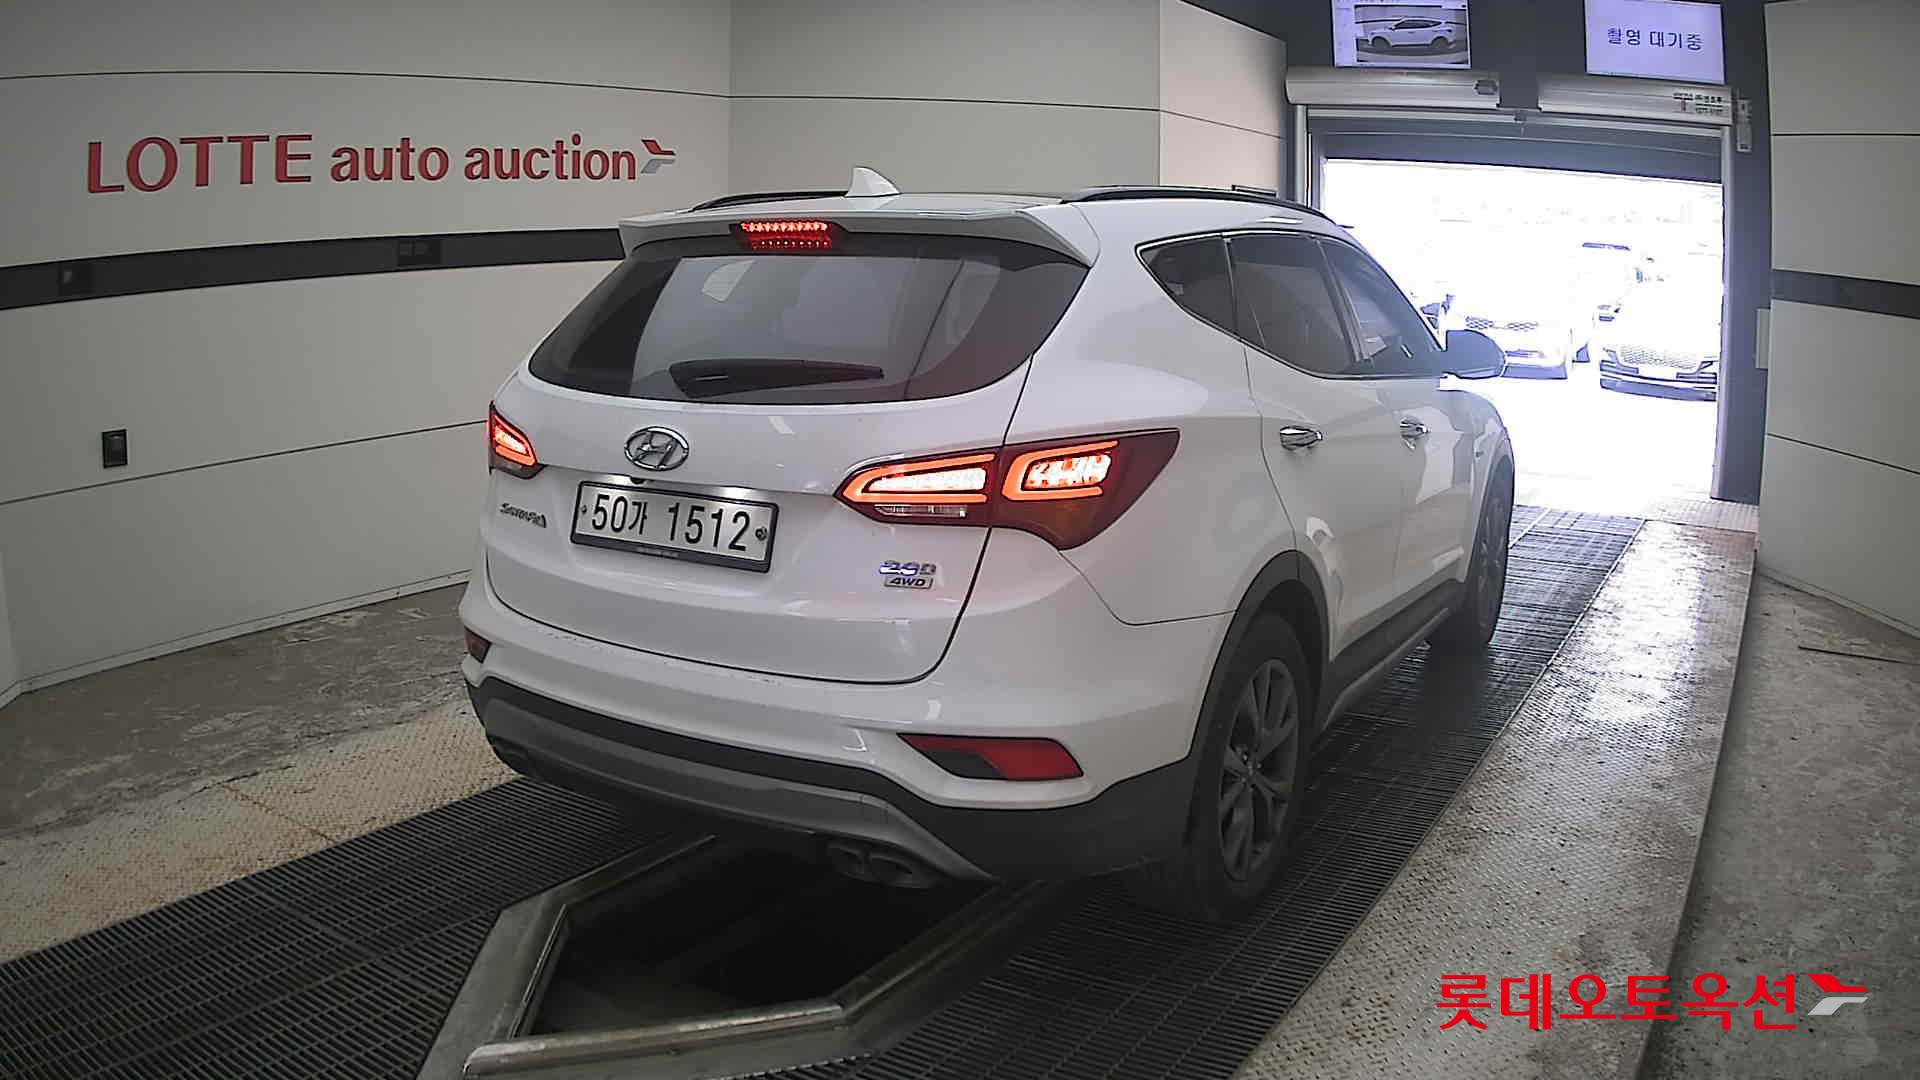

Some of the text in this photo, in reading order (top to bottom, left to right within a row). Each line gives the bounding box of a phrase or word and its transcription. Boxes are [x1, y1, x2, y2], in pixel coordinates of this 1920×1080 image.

[1649, 31, 1703, 51] 대기중
[87, 133, 637, 193] LOTTE auto auction
[591, 493, 648, 535] 50가
[668, 502, 751, 552] 1512
[889, 577, 926, 587] AWD
